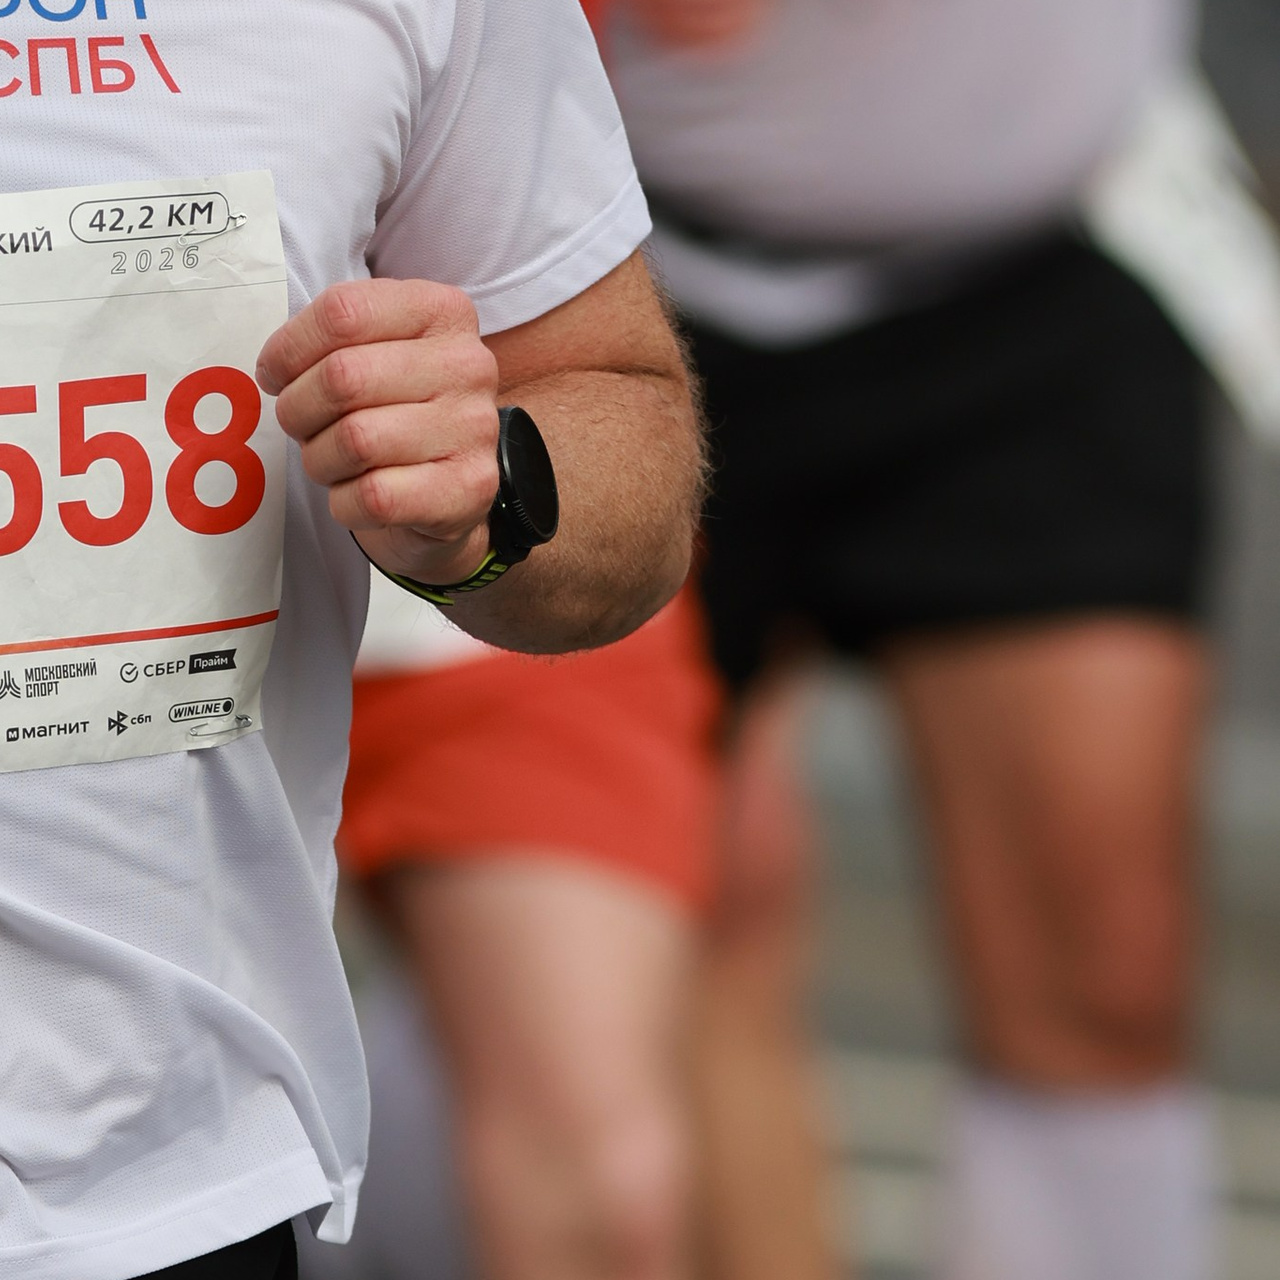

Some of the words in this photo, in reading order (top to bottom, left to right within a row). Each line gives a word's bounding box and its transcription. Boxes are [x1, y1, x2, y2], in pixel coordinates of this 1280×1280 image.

[89, 206, 154, 234] 42,2
[168, 201, 214, 227] КМ
[111, 246, 199, 275] 2026
[24, 658, 97, 682] МОСКОВСКИЙ
[144, 660, 186, 677] СБЕР
[193, 655, 228, 669] Прайм
[26, 681, 59, 698] СПОРТ
[130, 714, 152, 725] сбп
[174, 703, 221, 718] WINLINE
[22, 721, 90, 739] магнит
